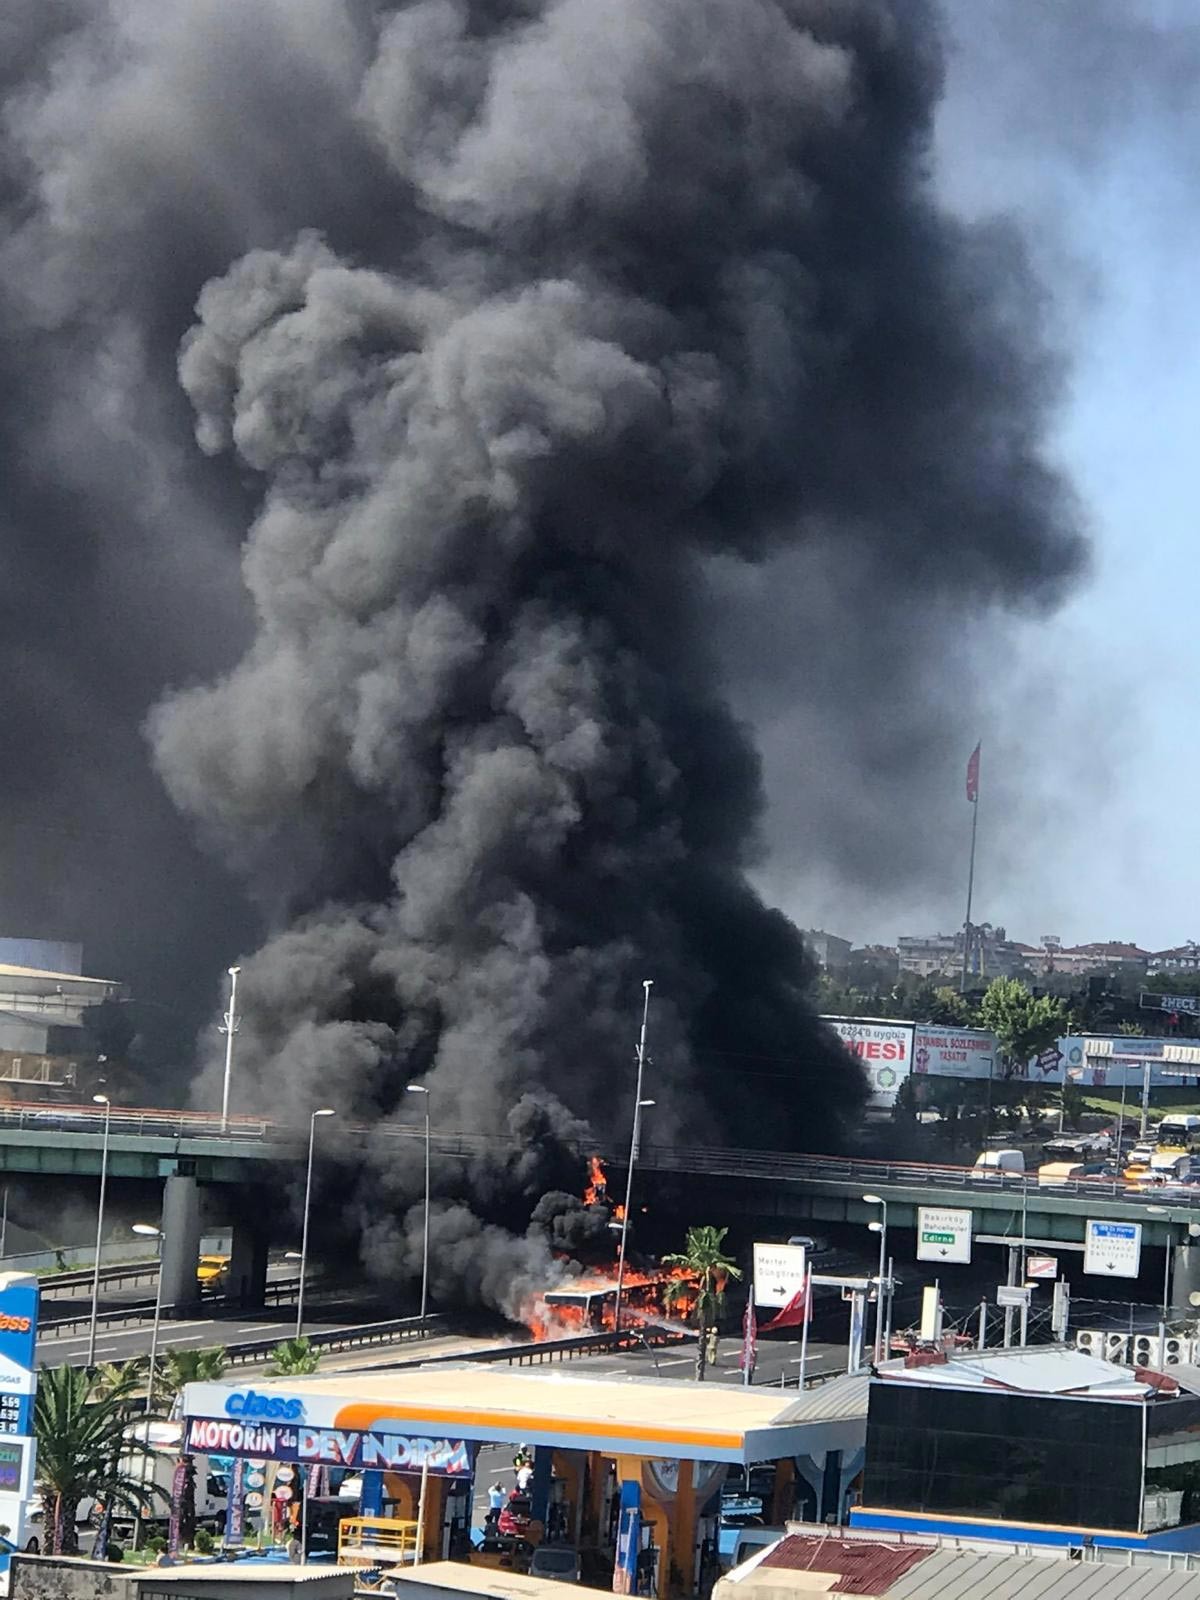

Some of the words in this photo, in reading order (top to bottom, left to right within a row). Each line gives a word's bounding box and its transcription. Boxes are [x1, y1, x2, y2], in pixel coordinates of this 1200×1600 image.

[923, 1234, 953, 1243] Edirne
[225, 1390, 303, 1419] class
[298, 1428, 359, 1465] DEV
